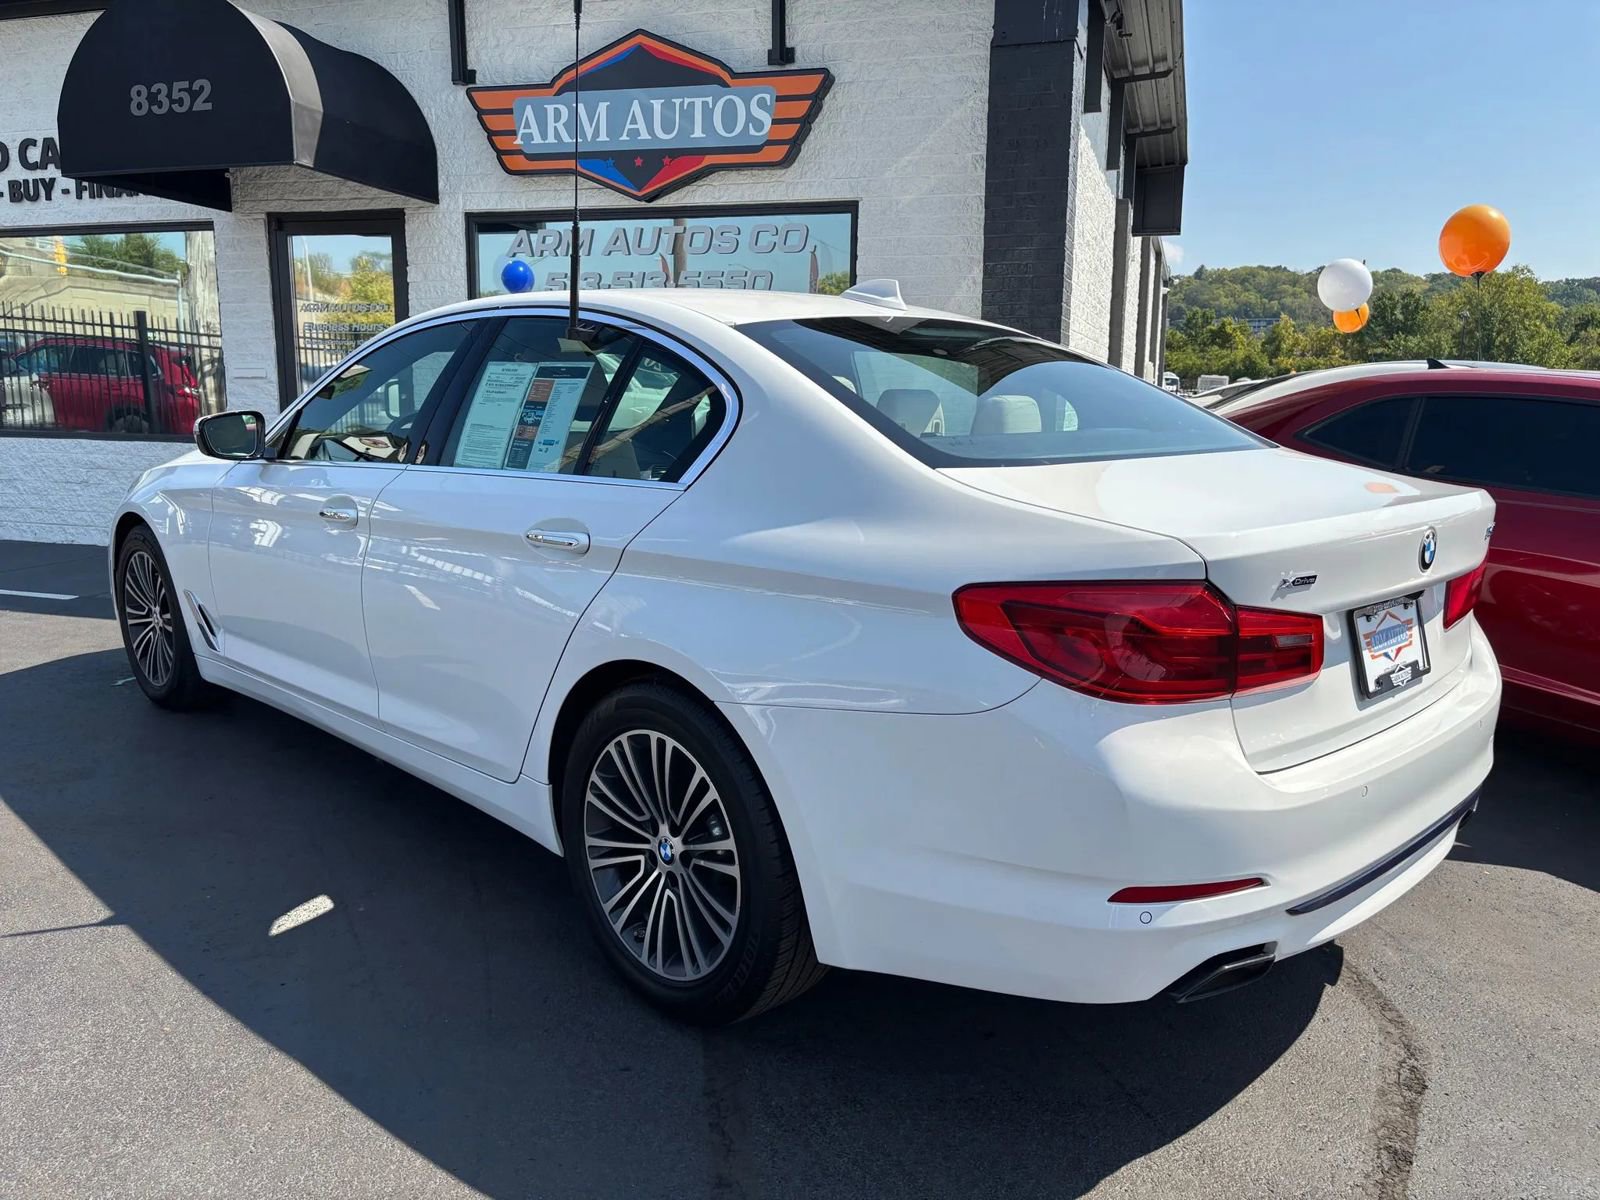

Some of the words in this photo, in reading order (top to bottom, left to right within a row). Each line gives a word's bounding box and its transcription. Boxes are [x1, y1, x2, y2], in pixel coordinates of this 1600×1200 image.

[130, 79, 213, 116] 8352
[513, 102, 610, 144] ARM
[619, 93, 771, 141] AUTOS
[8, 178, 56, 203] BUY
[506, 228, 595, 257] ARM
[601, 225, 741, 256] AUTOS
